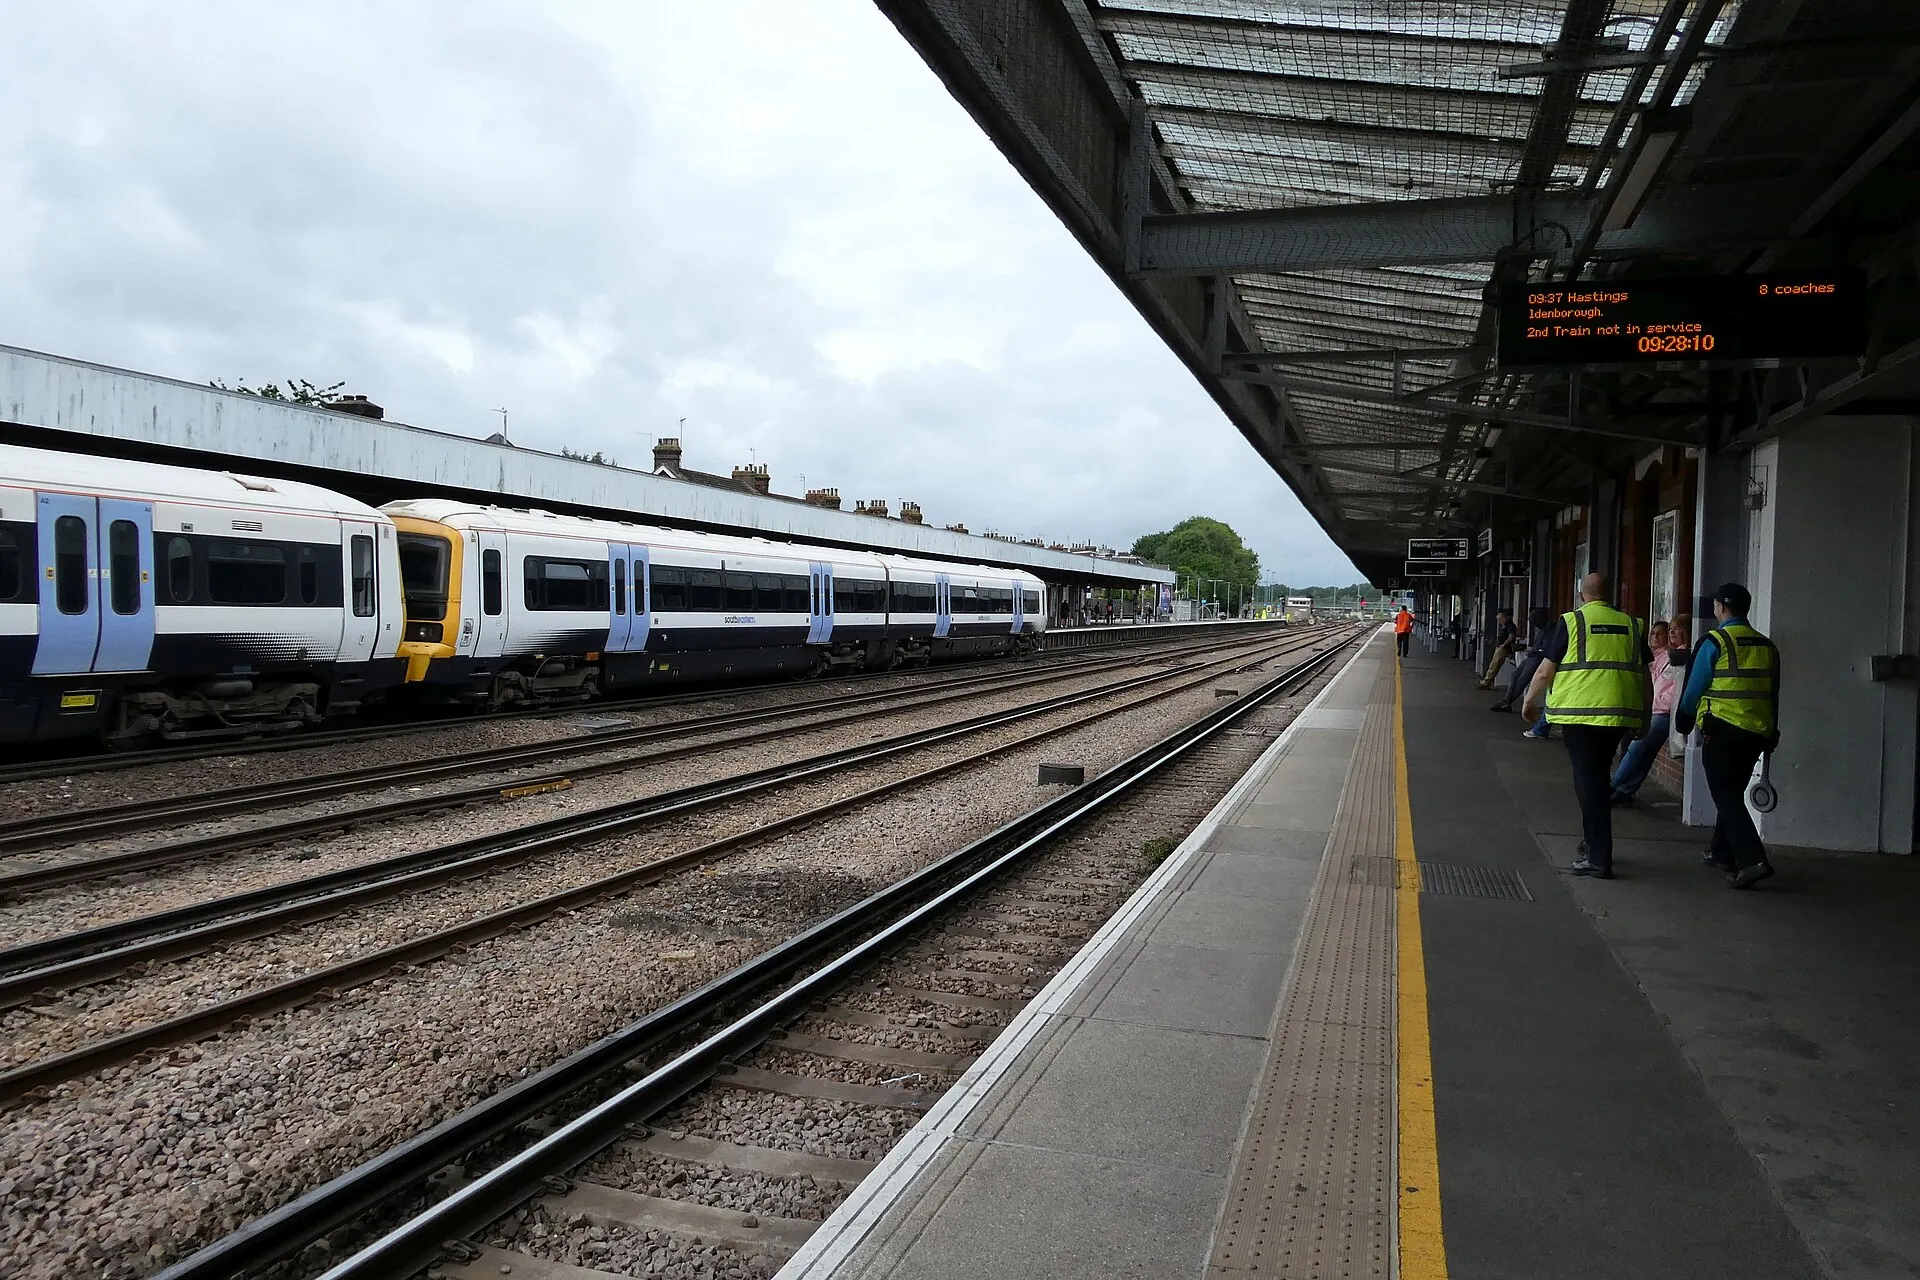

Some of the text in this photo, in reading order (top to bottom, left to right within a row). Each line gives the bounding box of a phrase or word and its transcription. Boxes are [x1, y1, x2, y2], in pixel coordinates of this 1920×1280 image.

[1759, 282, 1835, 295] 8 coaches
[1528, 291, 1629, 304] 09:37 Hastings
[1527, 321, 1702, 338] 2nd Train not in service
[1638, 334, 1715, 353] 09:28:10
